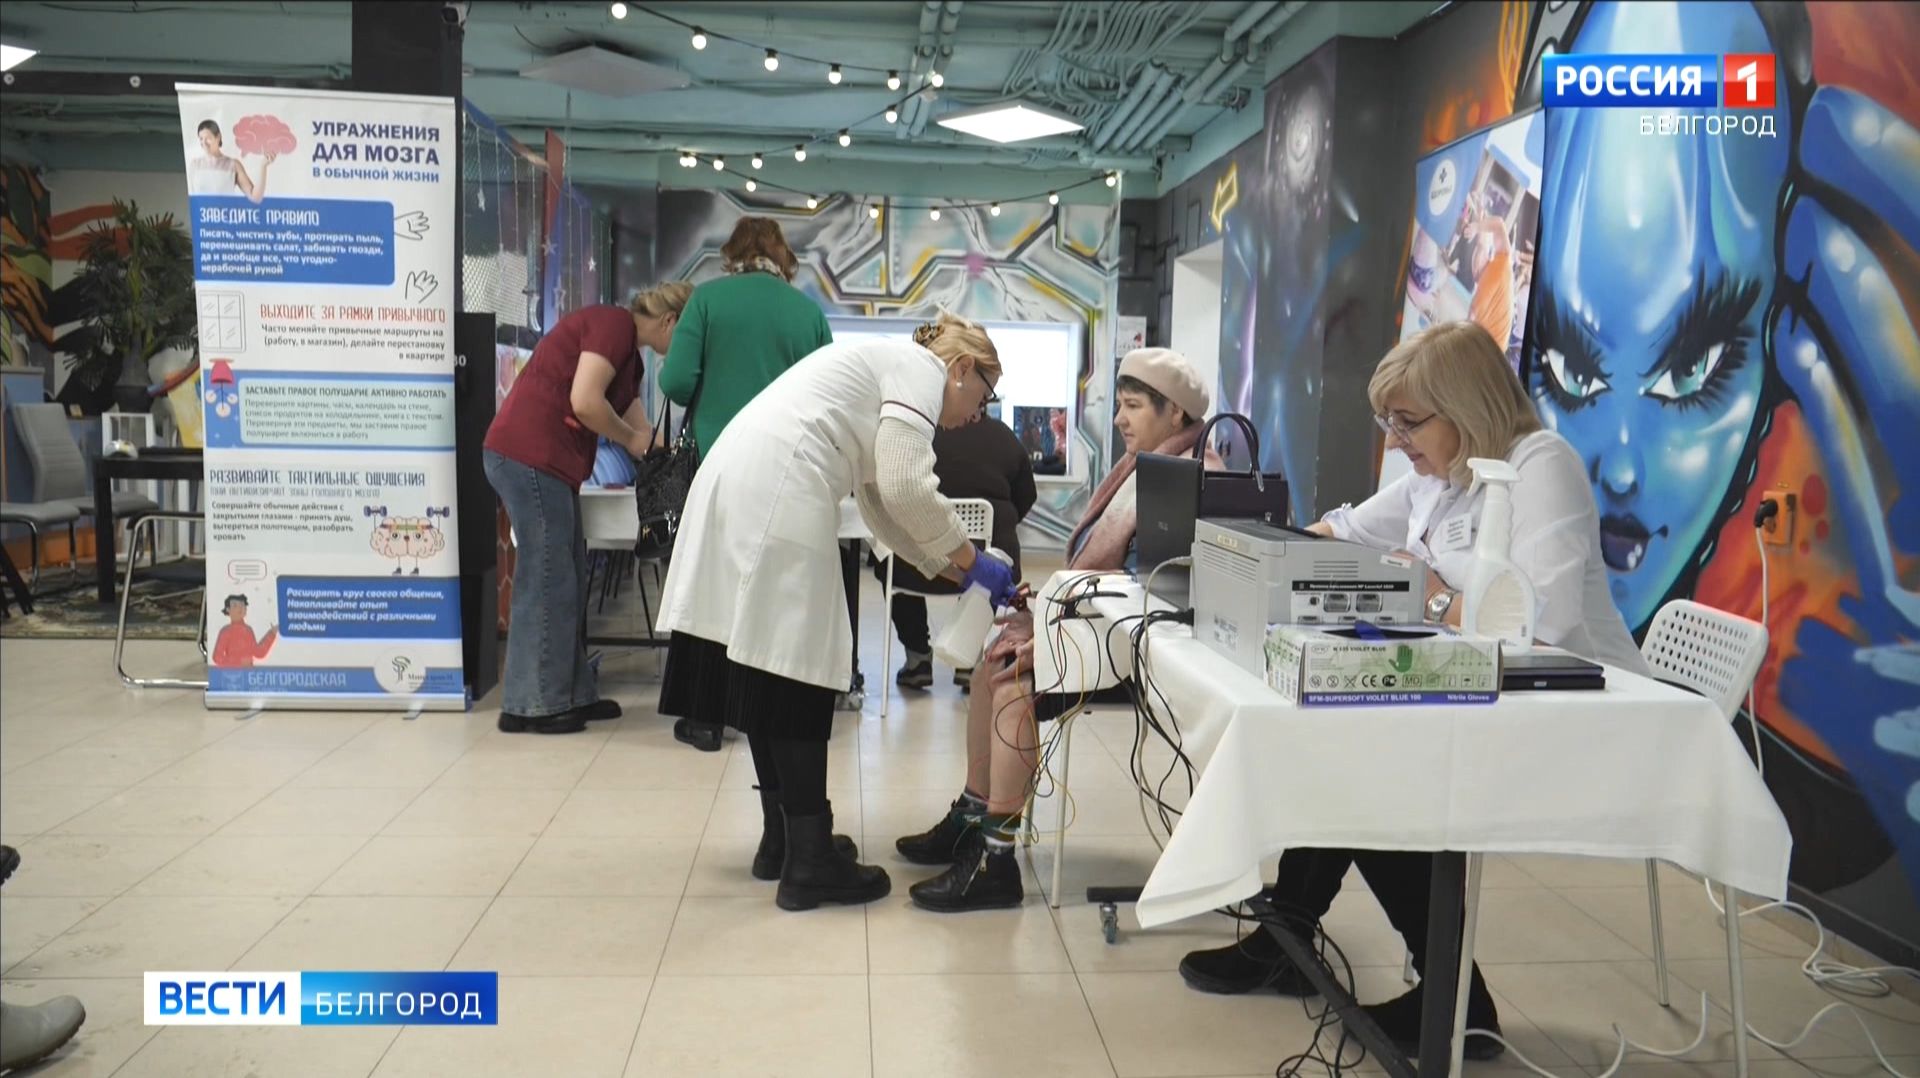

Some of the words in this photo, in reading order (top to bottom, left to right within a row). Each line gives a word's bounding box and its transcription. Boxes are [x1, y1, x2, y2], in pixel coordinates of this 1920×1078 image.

[312, 121, 440, 142] УПРАЖНЕНИЯ
[312, 142, 357, 163] ДЛЯ
[365, 144, 440, 166] МОЗГА
[312, 167, 321, 178] В
[324, 167, 389, 180] ОБЫЧНОЙ
[393, 170, 439, 183] ЖИЗНИ
[200, 207, 260, 224] ЗАВЕДИТЕ
[266, 208, 320, 226] ПРАВИЛО
[200, 228, 234, 239] Писать,
[236, 231, 274, 239] чистить
[276, 231, 302, 241] зубы,
[304, 233, 354, 243] протирать
[356, 234, 384, 244] пыль,
[200, 241, 272, 251] перемешивать
[273, 243, 301, 253] салат,
[303, 242, 347, 253] забивать
[348, 246, 384, 256] гвозди,
[201, 253, 211, 262] да
[222, 252, 260, 263] вообще
[262, 255, 281, 263] все,
[283, 255, 299, 263] что
[301, 255, 337, 266] угодно-
[201, 263, 252, 274] нерабочей
[254, 265, 283, 275] рукой
[260, 303, 316, 320] ВЫХОДИТЕ
[321, 304, 335, 320] ЗА
[339, 305, 374, 321] РАМКИ
[378, 306, 446, 323] ПРИВЫЧНОГО
[261, 323, 286, 333] Часто
[288, 325, 326, 334] меняйте
[328, 326, 382, 335] привычные
[383, 328, 431, 337] маршруты
[432, 329, 444, 337] на
[264, 336, 298, 347] (работу,
[307, 338, 348, 348] магазин),
[350, 339, 385, 349] делайте
[387, 341, 445, 350] перестановку
[405, 353, 445, 361] квартире
[245, 386, 285, 395] ЗАСТАВЬТЕ
[288, 387, 317, 396] ПРАВОЕ
[319, 387, 368, 397] ПОЛУШАРИЕ
[371, 388, 407, 397] АКТИВНО
[409, 389, 446, 398] РАБОТАТЬ
[209, 468, 282, 484] РАЗВИВАЙТЕ
[288, 470, 360, 486] ТАКТИЛЬНЫЕ
[365, 471, 425, 486] ОЩУЩЕНИЯ
[212, 501, 261, 510] Совершайте
[301, 502, 338, 511] действия
[213, 513, 259, 521] закрытыми
[299, 514, 332, 522] принять
[213, 523, 259, 531] вытереться
[313, 524, 354, 532] разобрать
[286, 587, 341, 599] Расширять
[343, 590, 364, 599] круг
[366, 590, 398, 598] своего
[399, 588, 444, 599] общения,
[287, 599, 358, 609] Накапливайте
[359, 601, 388, 609] опыт
[287, 611, 368, 620] взаимодействий
[376, 613, 437, 621] различными
[288, 622, 326, 631] людьми
[248, 671, 346, 687] БЕЛГОРОДСКАЯ
[1390, 694, 1408, 702] BLUE
